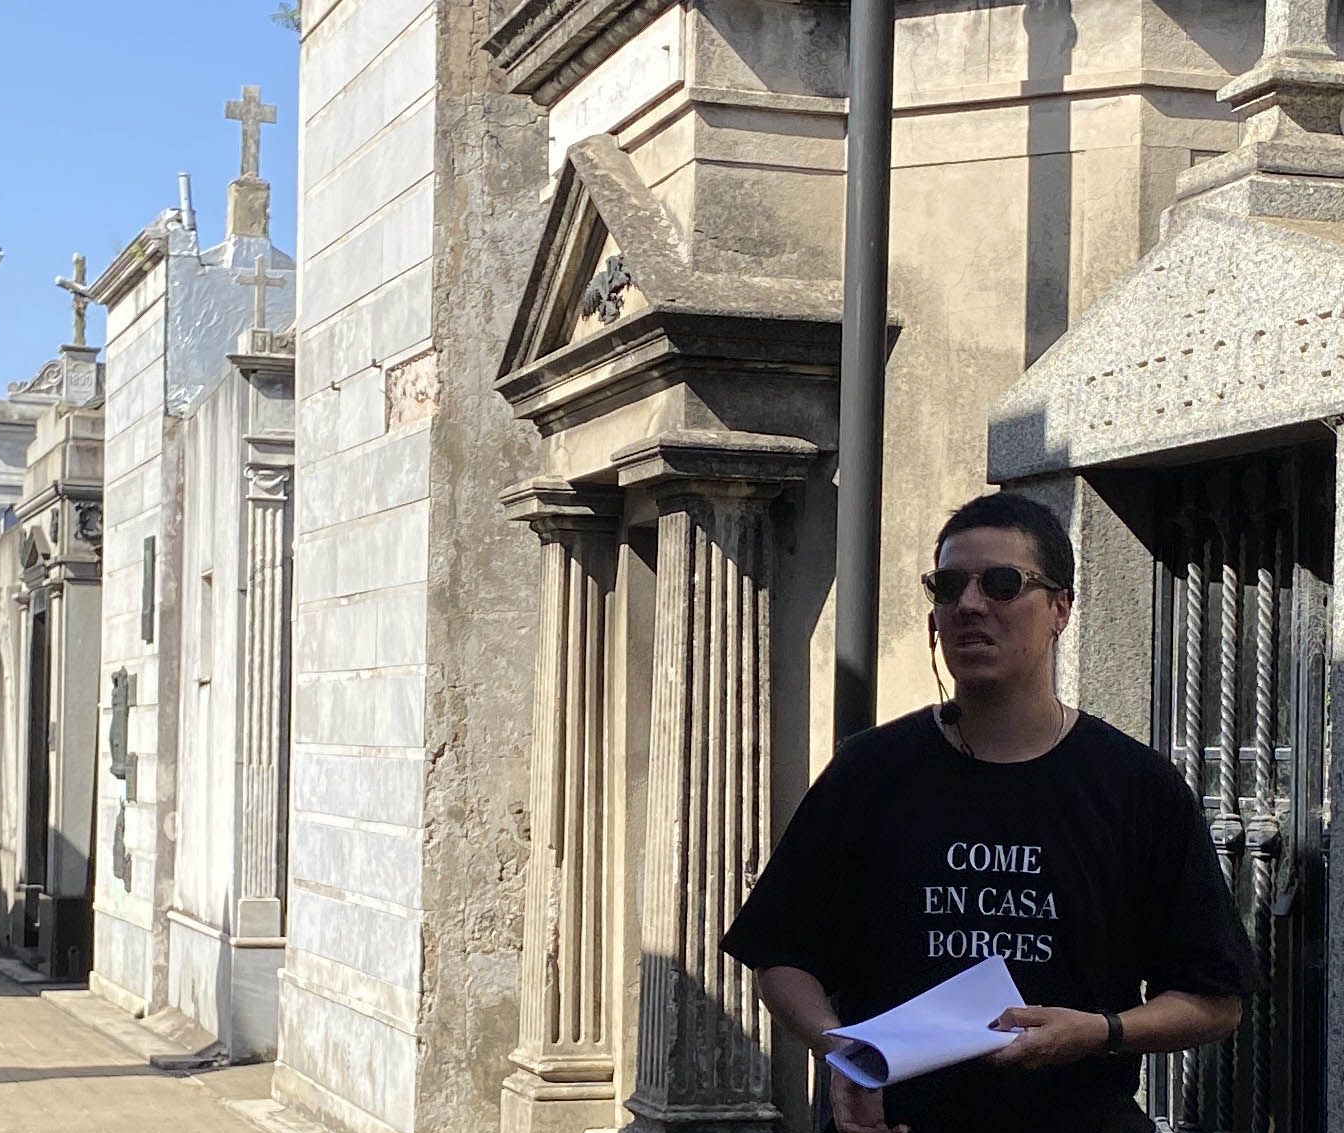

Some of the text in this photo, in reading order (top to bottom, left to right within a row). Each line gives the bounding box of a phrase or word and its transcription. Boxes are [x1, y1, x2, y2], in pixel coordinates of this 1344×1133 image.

[946, 842, 1042, 874] COME
[923, 886, 1060, 920] EN CASA
[927, 930, 1053, 963] BORGES
